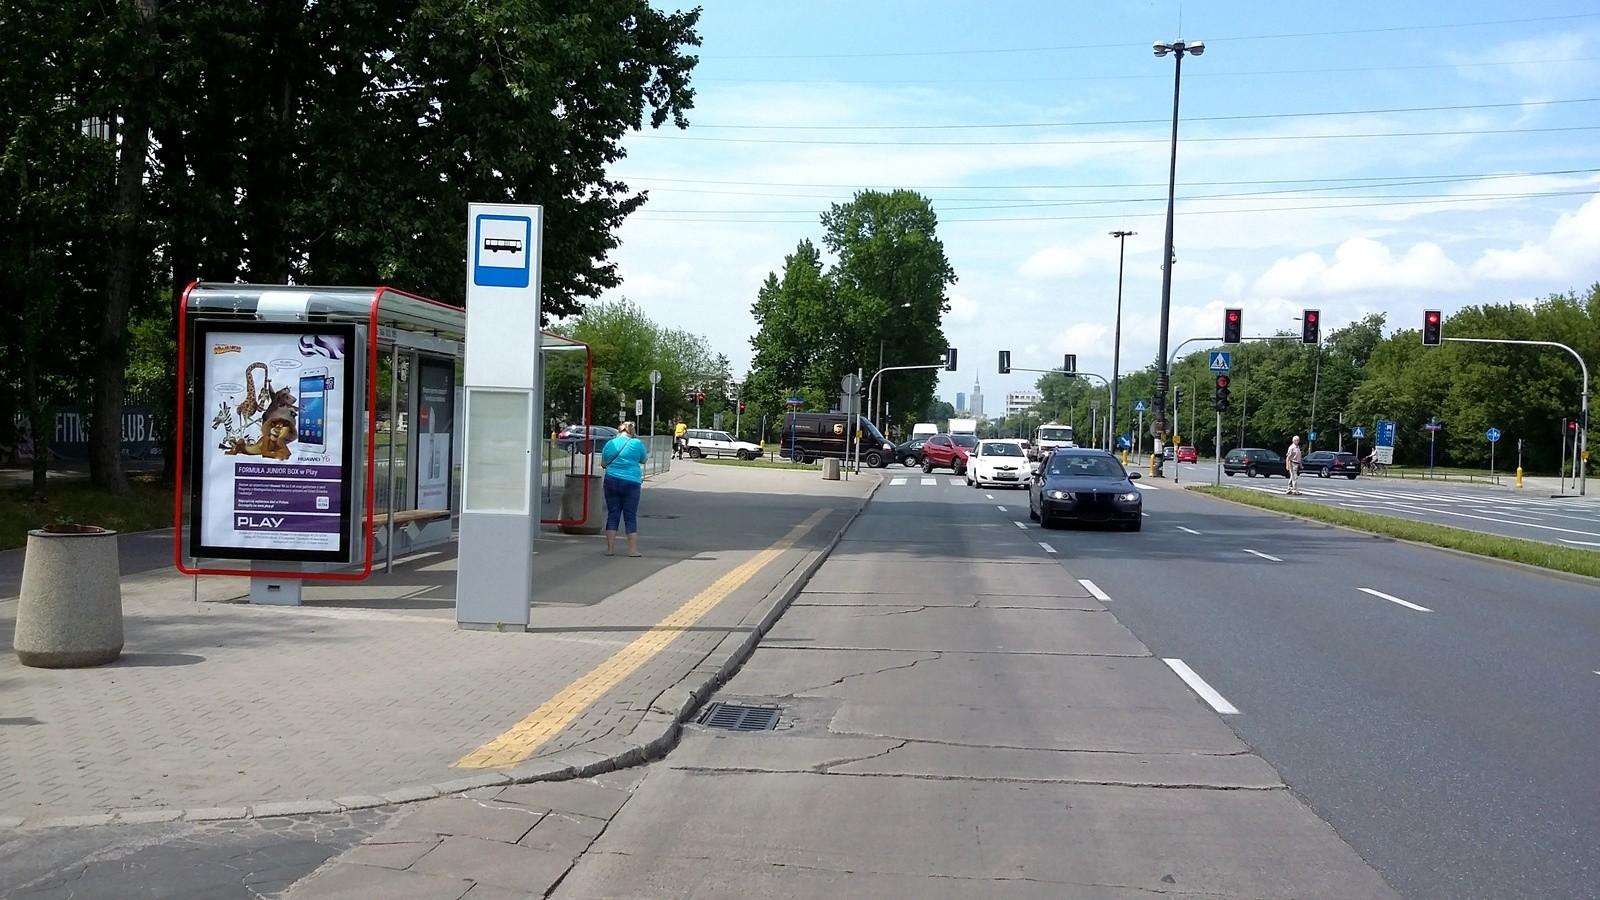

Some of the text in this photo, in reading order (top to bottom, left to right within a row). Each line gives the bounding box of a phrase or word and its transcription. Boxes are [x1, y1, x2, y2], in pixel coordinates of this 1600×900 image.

[55, 412, 89, 442] FITN
[121, 413, 145, 442] LUB
[238, 466, 265, 474] FORMULA
[266, 467, 286, 475] JUNIOR
[305, 468, 318, 477] Play
[237, 516, 284, 528] PLAY
